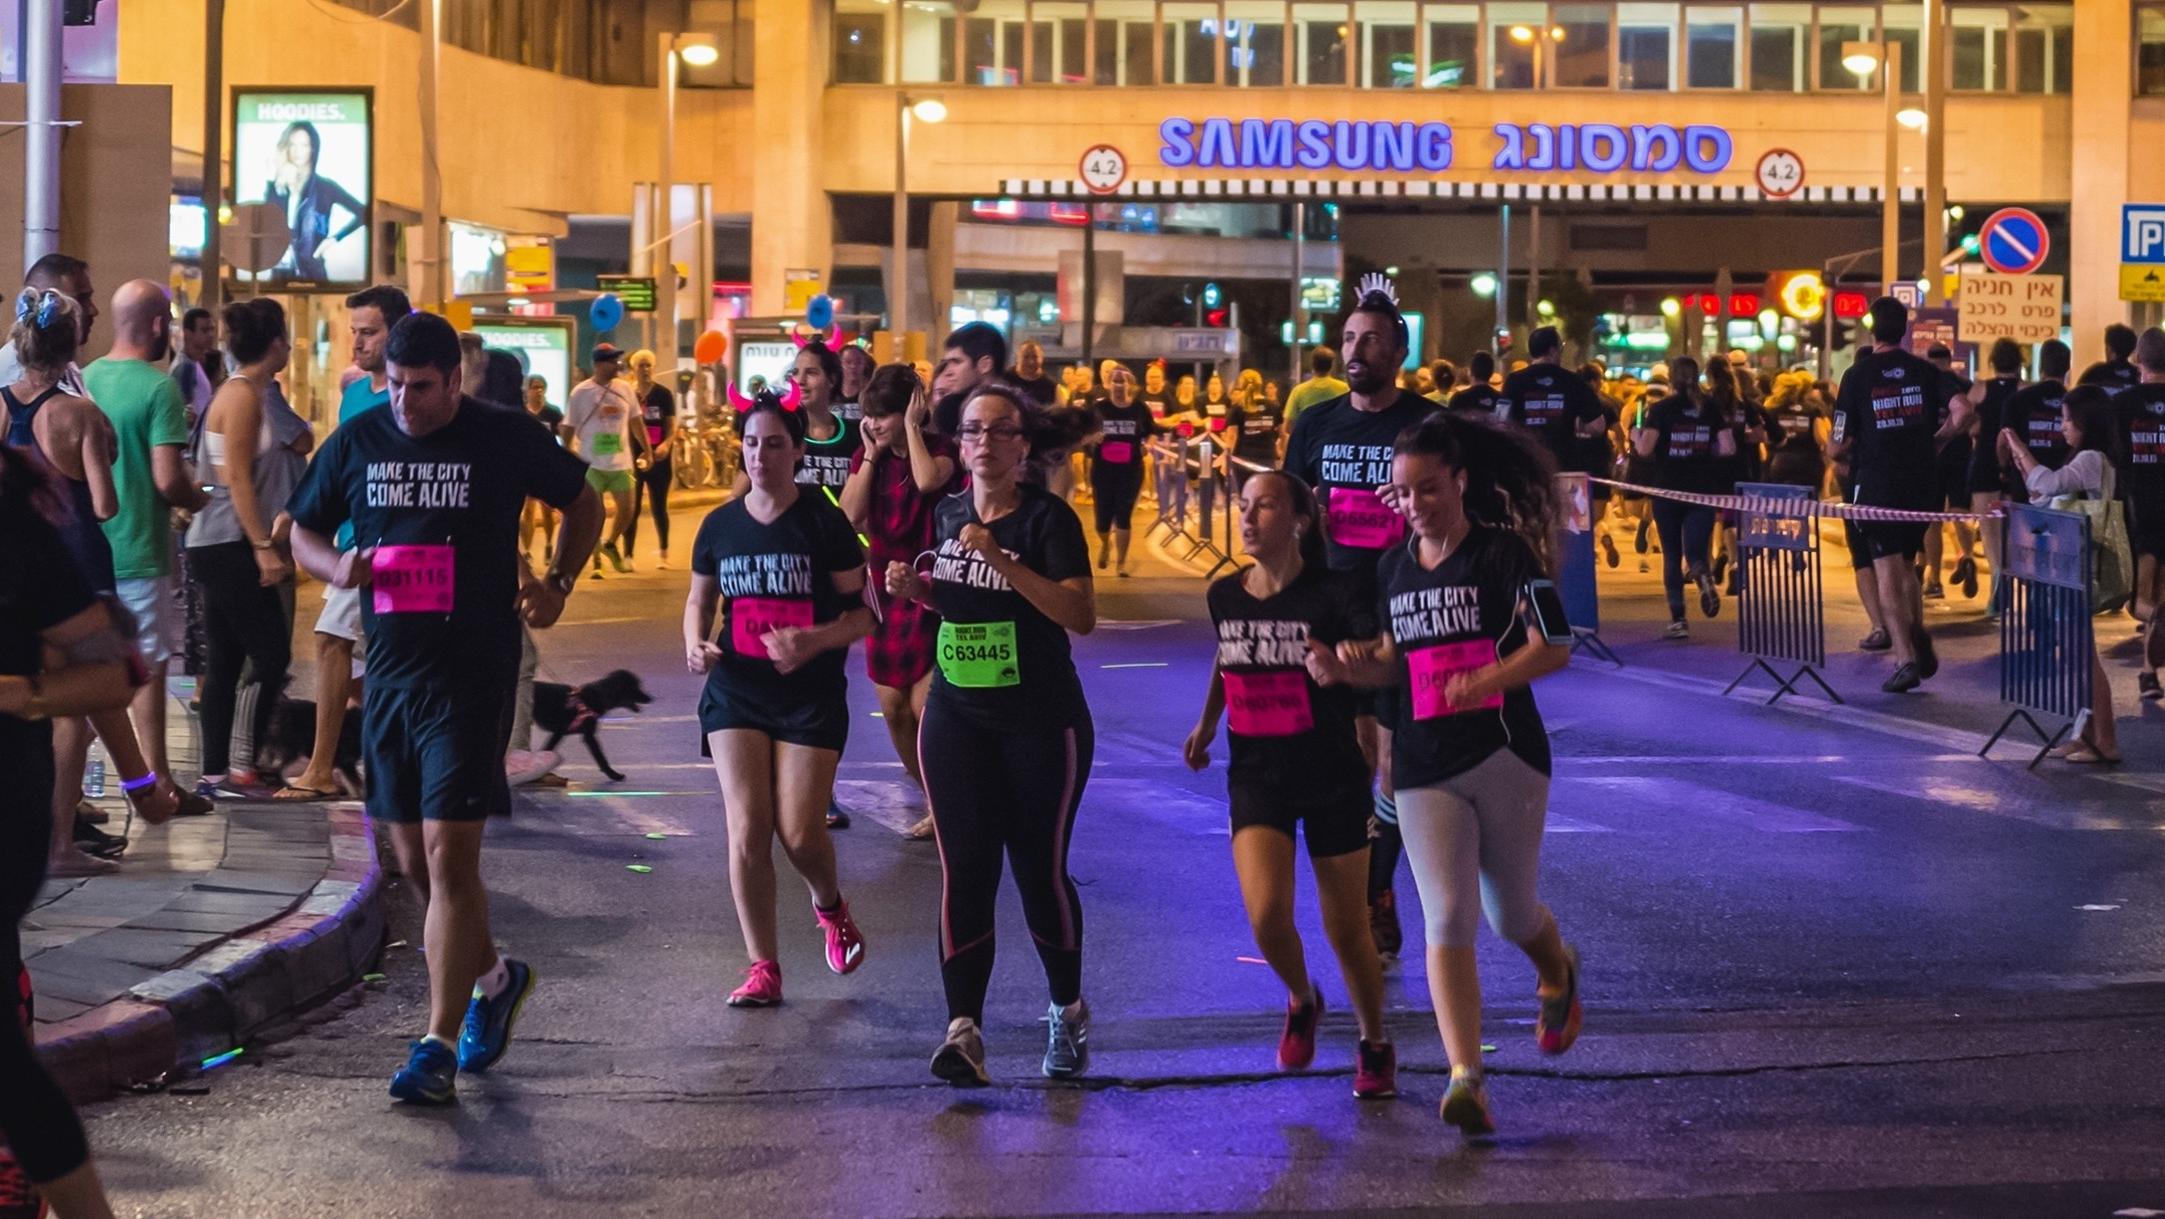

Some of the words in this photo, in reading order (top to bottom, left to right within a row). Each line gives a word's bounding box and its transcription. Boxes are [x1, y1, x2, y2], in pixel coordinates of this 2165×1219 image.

[257, 103, 346, 120] HOODIES.
[1159, 117, 1453, 171] SAMSUNG
[1493, 123, 1733, 173] סמסונג
[1090, 160, 1117, 175] 4.2
[1767, 163, 1794, 180] 4.2
[1967, 279, 2013, 296] חניה
[2027, 282, 2054, 300] אין
[1967, 302, 2006, 316] לרכב
[2022, 305, 2055, 318] פרט
[1966, 321, 2014, 336] והצלה
[2019, 325, 2055, 337] כיבוי
[1322, 444, 1355, 460] MAKE
[1358, 446, 1381, 461] THE
[367, 461, 404, 481] MAKE
[408, 463, 434, 480] THE
[437, 463, 471, 481] CITY
[1322, 461, 1363, 483] COME
[1366, 462, 1392, 484] ALI
[367, 482, 414, 507] COME
[418, 482, 470, 508] ALIVE
[720, 571, 763, 598] COME
[767, 570, 813, 595] ALIVE
[1418, 587, 1442, 611] THE
[1444, 586, 1478, 608] CITY
[1392, 611, 1432, 644] COME
[1431, 606, 1481, 637] ALIVE
[943, 643, 1010, 661] C63445
